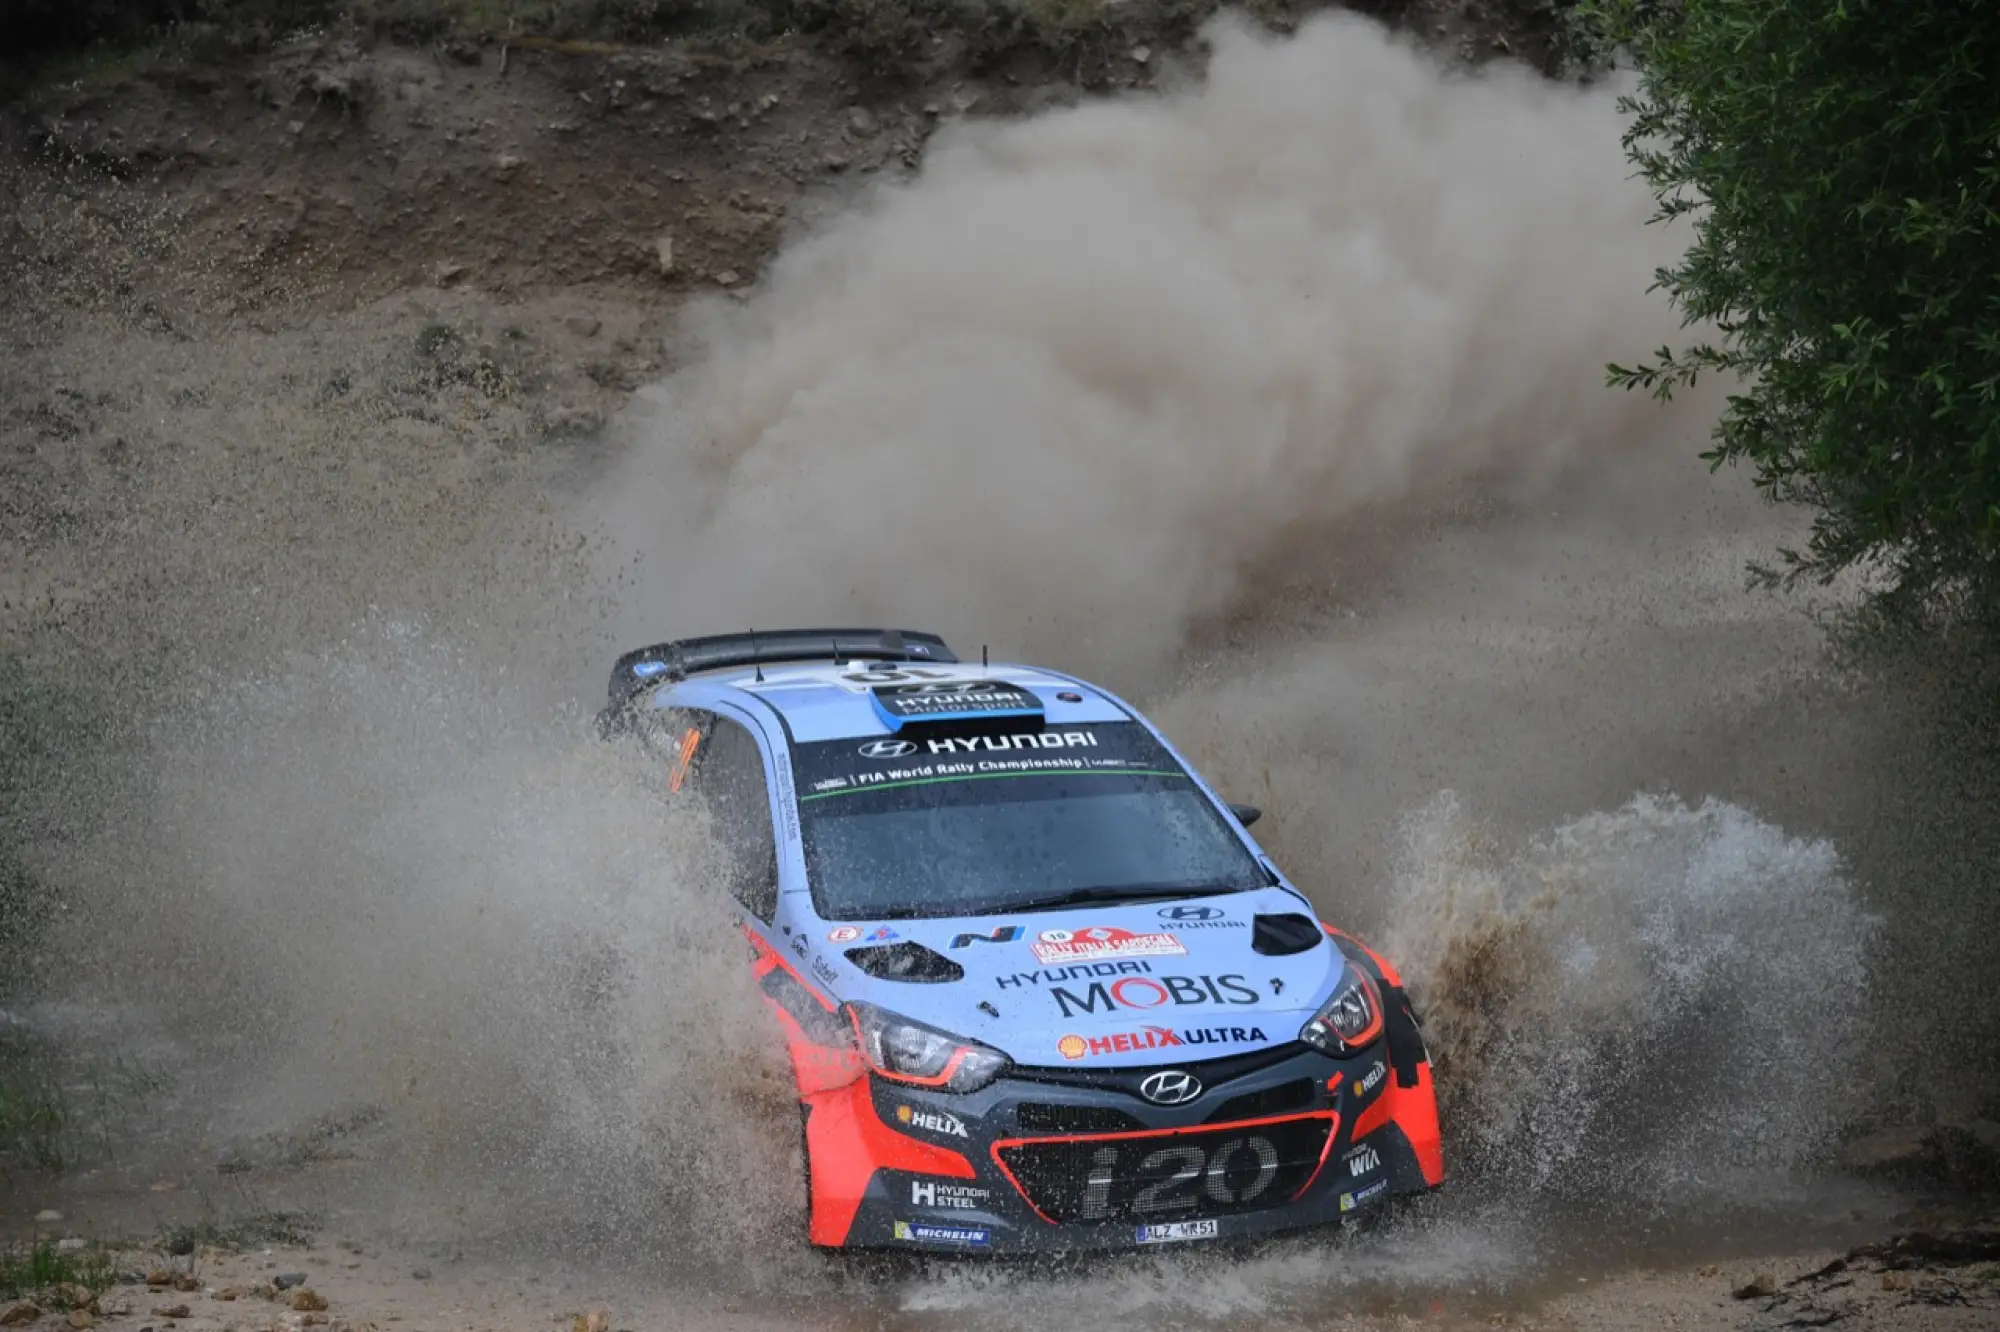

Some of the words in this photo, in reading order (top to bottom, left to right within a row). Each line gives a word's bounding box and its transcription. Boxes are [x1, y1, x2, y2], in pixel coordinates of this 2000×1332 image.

[895, 692, 1022, 707] HYUNDAI
[902, 701, 1028, 715] Motorsport
[927, 731, 1098, 755] HYUNDAI
[859, 774, 885, 785] FIA
[888, 766, 932, 780] World
[936, 762, 974, 774] Rally
[978, 757, 1083, 771] Championship
[1159, 921, 1247, 930] HYUNDAI
[996, 960, 1152, 989] HYUNDAI
[1049, 974, 1260, 1018] MOBIS
[1087, 1025, 1185, 1055] HELIX
[1184, 1026, 1268, 1045] ULTRA
[1362, 1060, 1386, 1092] HELIX
[912, 1111, 968, 1138] HELIX
[1350, 1148, 1381, 1176] WIA
[937, 1184, 990, 1198] HYUNDAI
[937, 1196, 976, 1208] STEEL
[916, 1228, 984, 1240] MICHELIN
